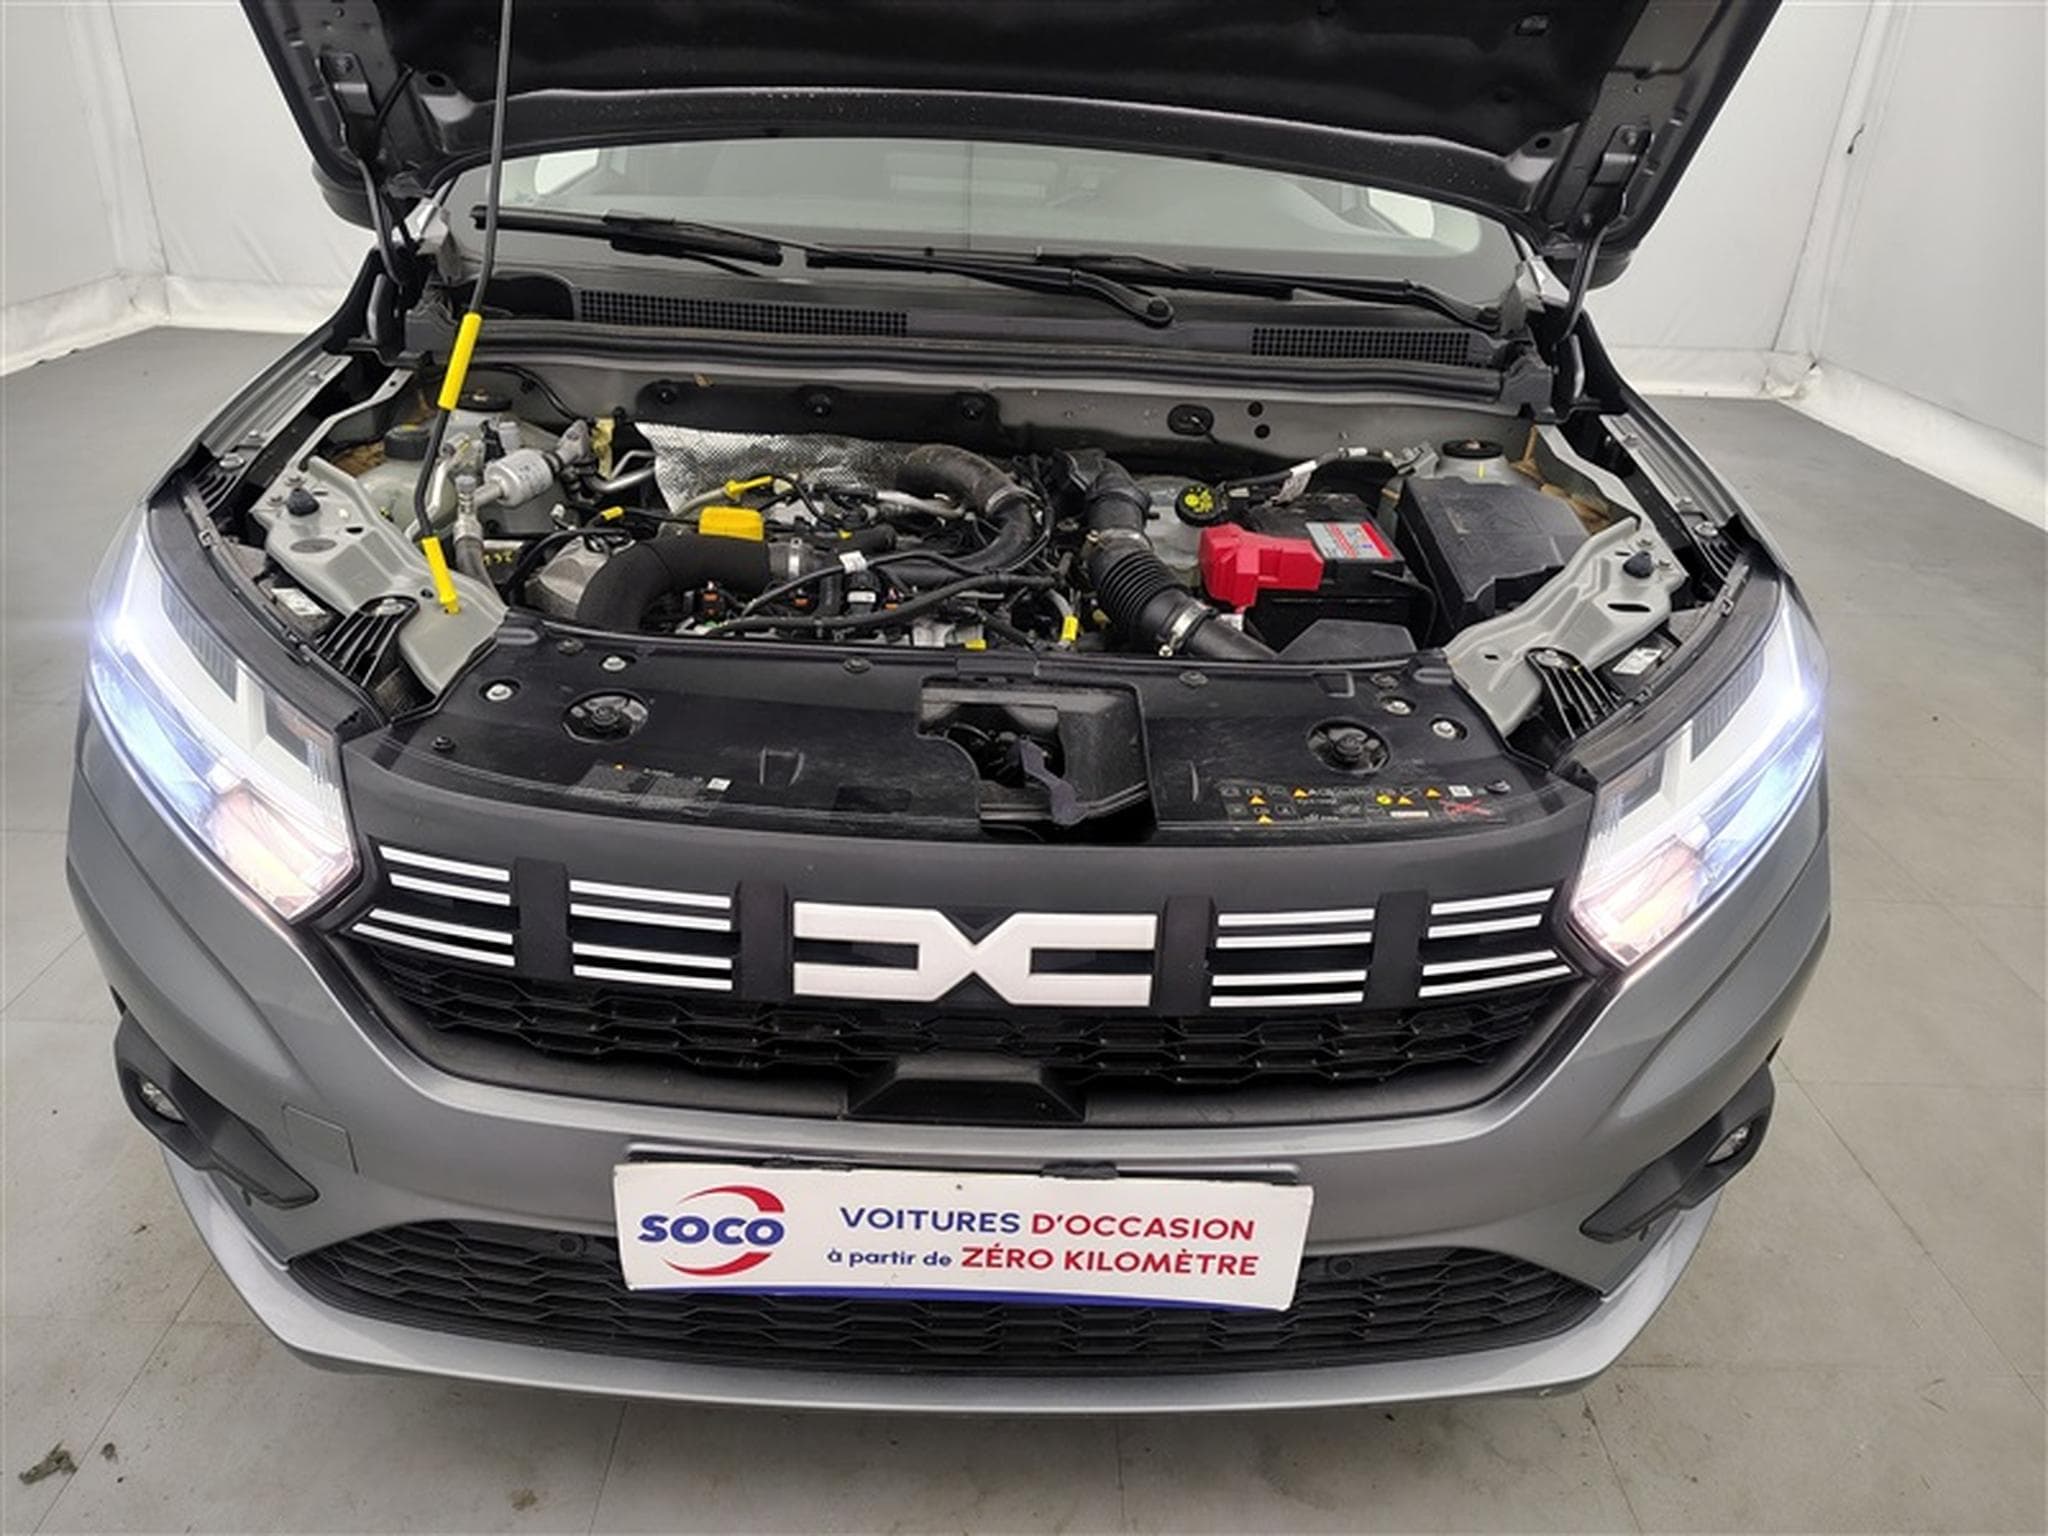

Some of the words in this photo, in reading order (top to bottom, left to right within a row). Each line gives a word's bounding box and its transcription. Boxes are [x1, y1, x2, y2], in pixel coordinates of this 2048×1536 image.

[638, 1214, 785, 1246] SOCO
[840, 1207, 1021, 1235] VOITURES
[1031, 1213, 1256, 1241] D'OCCASION
[827, 1248, 843, 1264] à
[848, 1248, 917, 1269] partir
[922, 1250, 953, 1268] de
[961, 1242, 1055, 1271] ZÉRO
[1063, 1248, 1260, 1277] KILOMÈTRE
